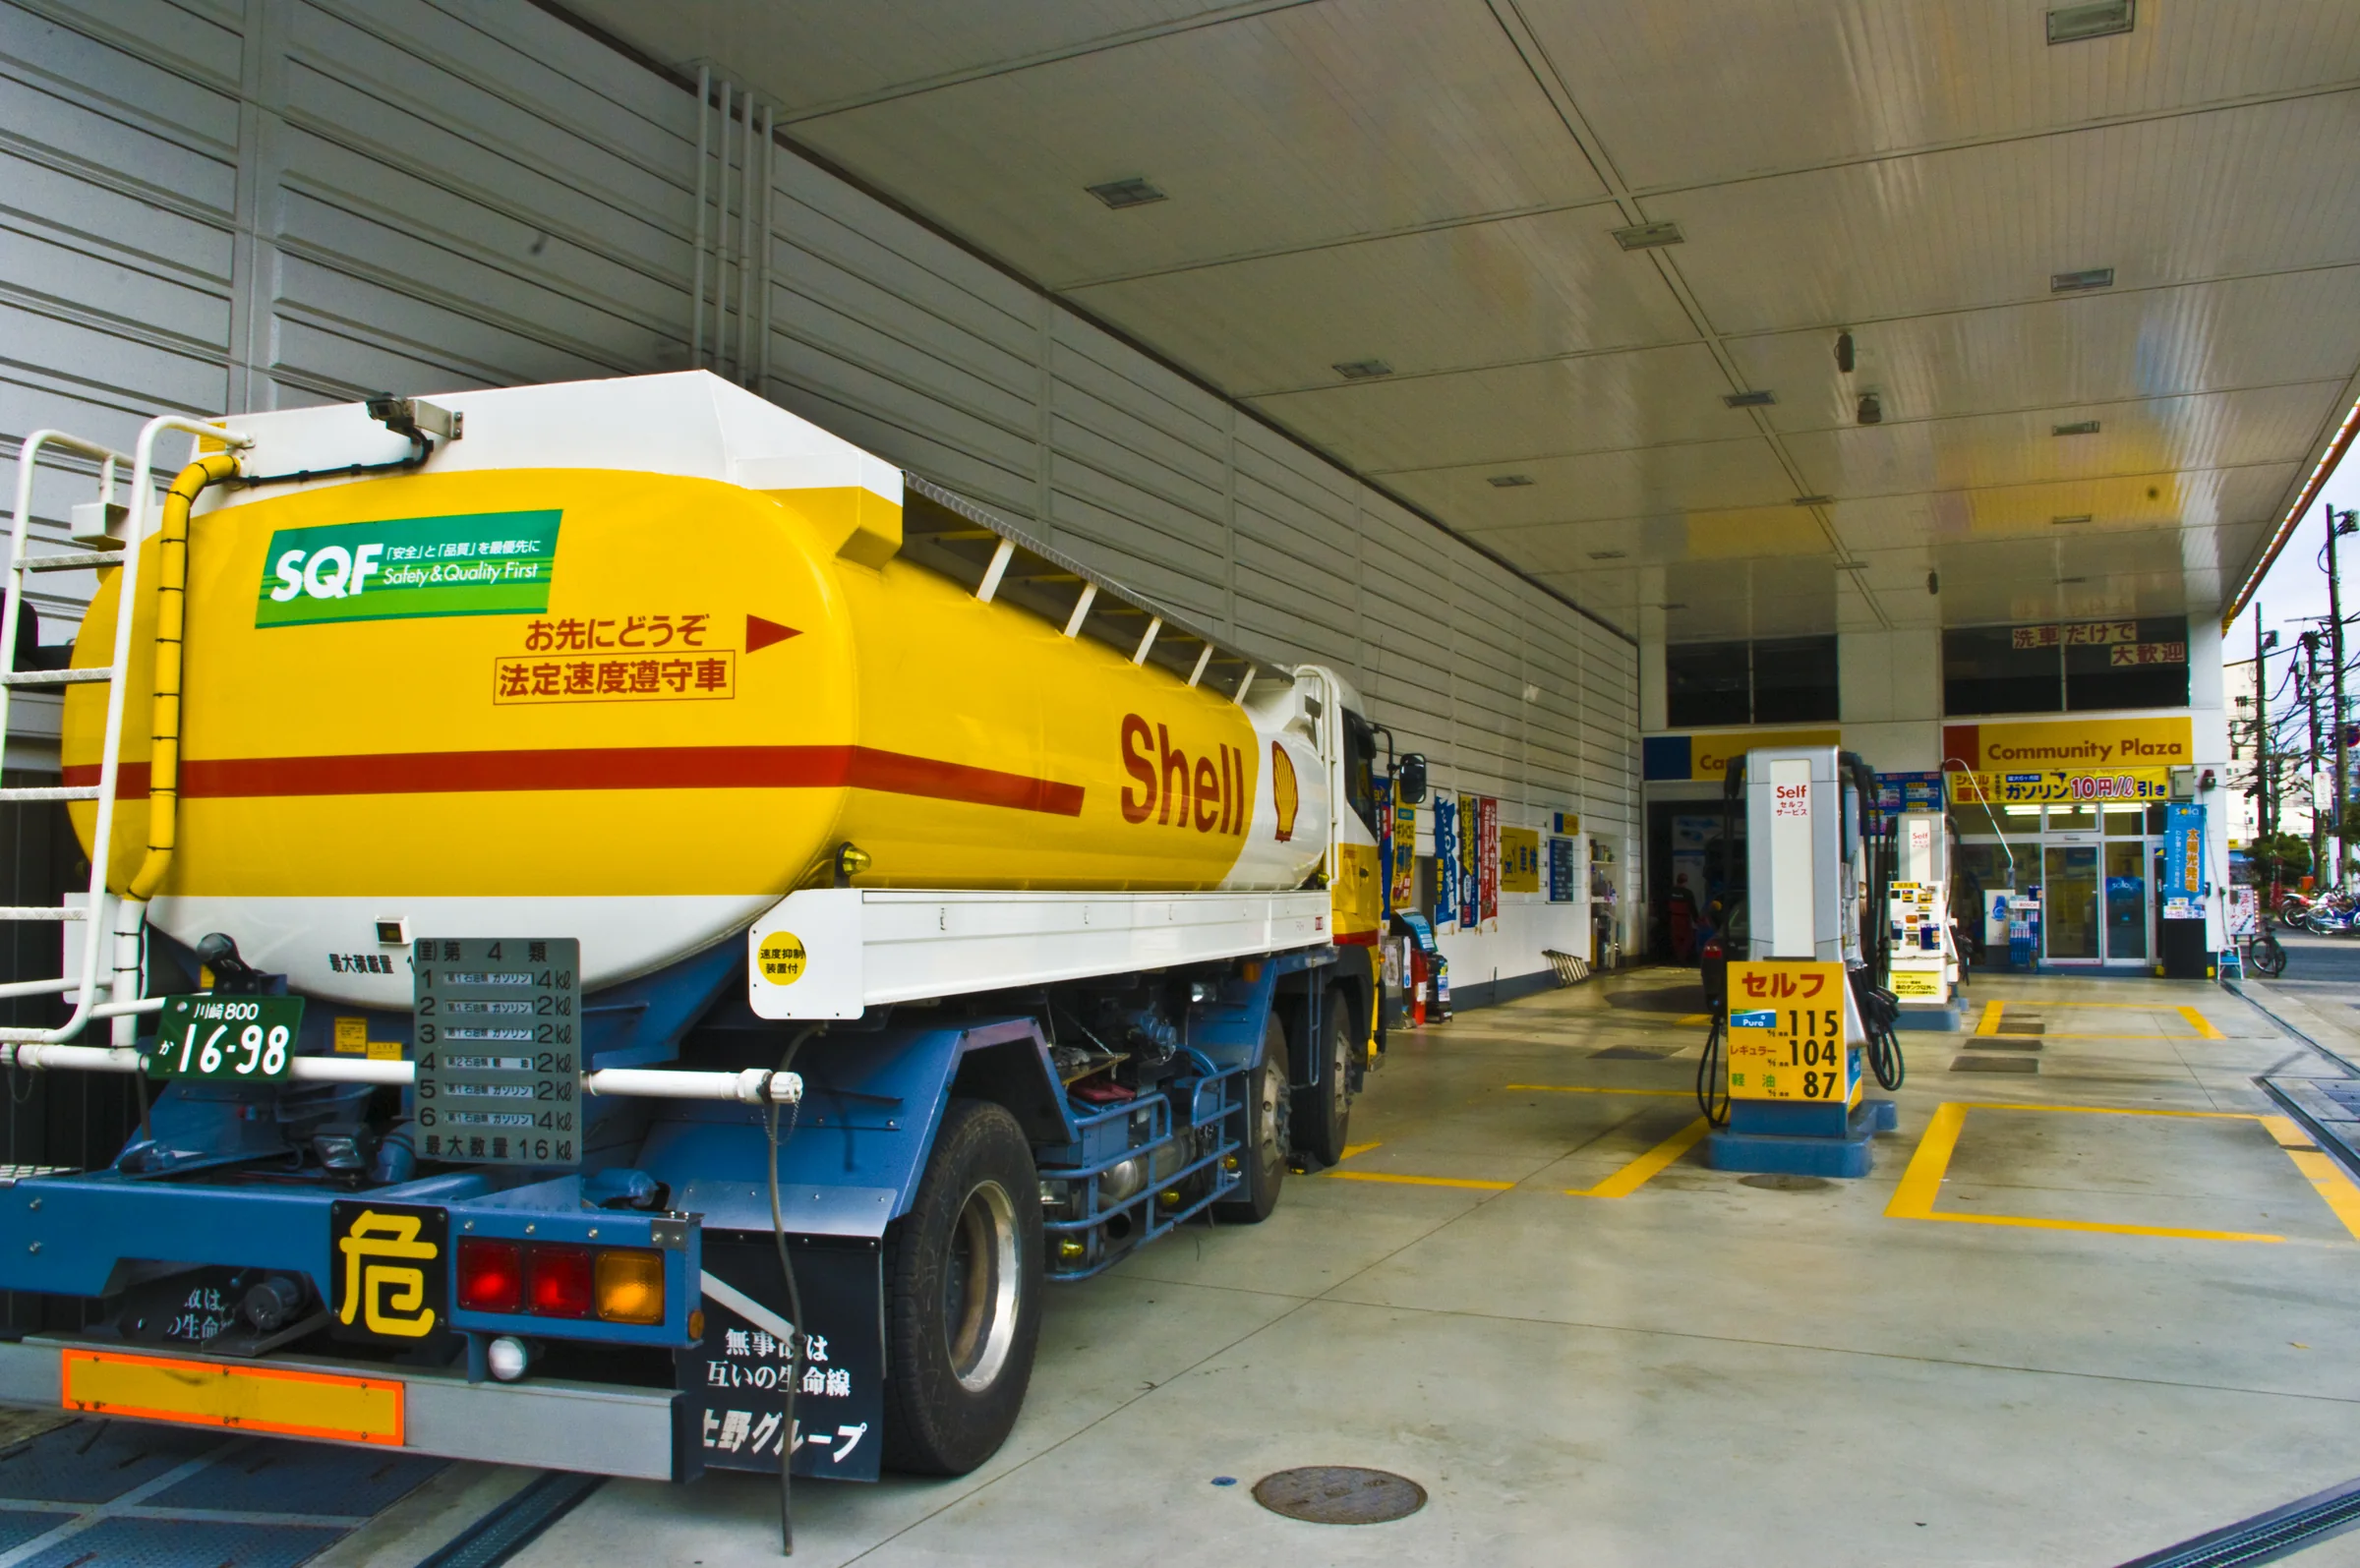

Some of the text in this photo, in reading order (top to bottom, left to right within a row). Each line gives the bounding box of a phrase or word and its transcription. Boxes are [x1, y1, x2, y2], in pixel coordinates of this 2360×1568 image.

[385, 539, 541, 561] 「安全」と「品質」を最優先に
[269, 543, 384, 603] SQF
[504, 562, 539, 579] First
[524, 613, 710, 652] お先にどうぞ
[2013, 622, 2135, 648] 洗車だけで
[2112, 643, 2185, 666] 大歓迎
[499, 657, 728, 697] 法定速度遵守車
[1987, 738, 2183, 762] Community Plaza
[1699, 754, 1729, 771] Ca
[1120, 713, 1245, 837] Shell
[1776, 784, 1807, 799] Self
[422, 969, 432, 989] 1
[765, 962, 798, 974] 装置付
[1741, 971, 1825, 999] セルフ
[419, 996, 437, 1016] 2
[419, 1023, 437, 1044] 3
[1742, 1018, 1764, 1027] Pura
[1789, 1010, 1839, 1037] 115
[158, 1023, 290, 1075] か 16-98
[1730, 1046, 1777, 1056] レギュラー
[1789, 1039, 1837, 1067] 104
[419, 1052, 436, 1072] 4
[420, 1079, 437, 1099] 5
[1732, 1071, 1838, 1099] 軽油 87
[420, 1107, 437, 1127] 6
[426, 1134, 509, 1158] 最大数量
[339, 1209, 439, 1338] 危
